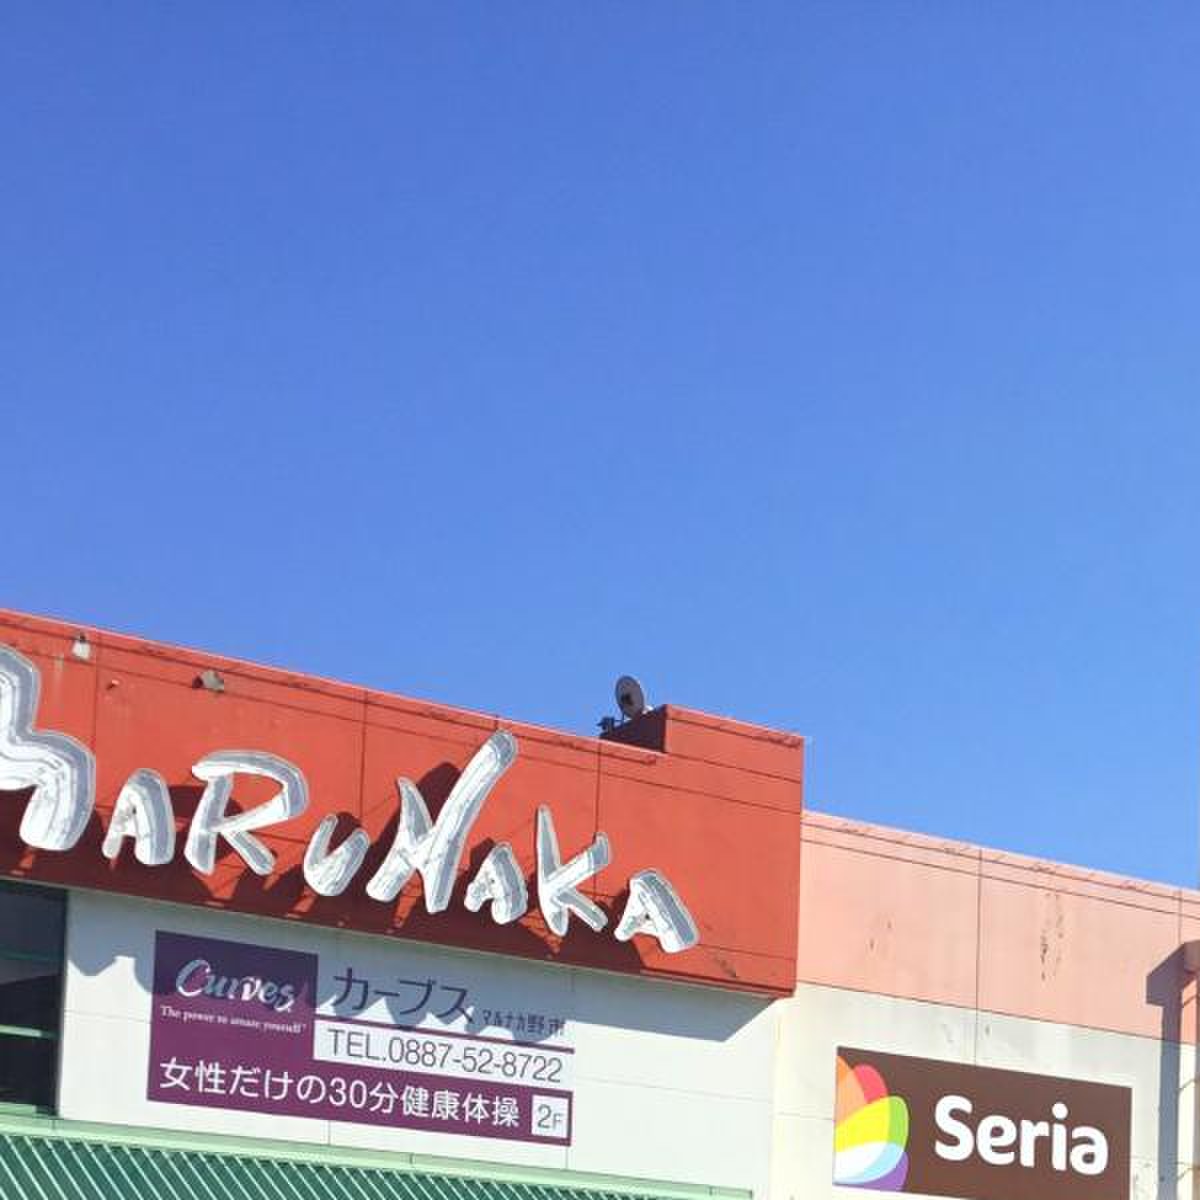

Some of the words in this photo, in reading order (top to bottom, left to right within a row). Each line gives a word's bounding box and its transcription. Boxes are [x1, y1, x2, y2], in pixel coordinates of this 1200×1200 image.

[175, 958, 297, 1014] Curves
[332, 966, 476, 1024] カーブス
[327, 1028, 563, 1084] TEL.0887-52-8722
[159, 1056, 520, 1128] 女性だけの30分健康体操
[537, 1105, 564, 1130] 2F
[934, 1094, 1109, 1175] Seria
